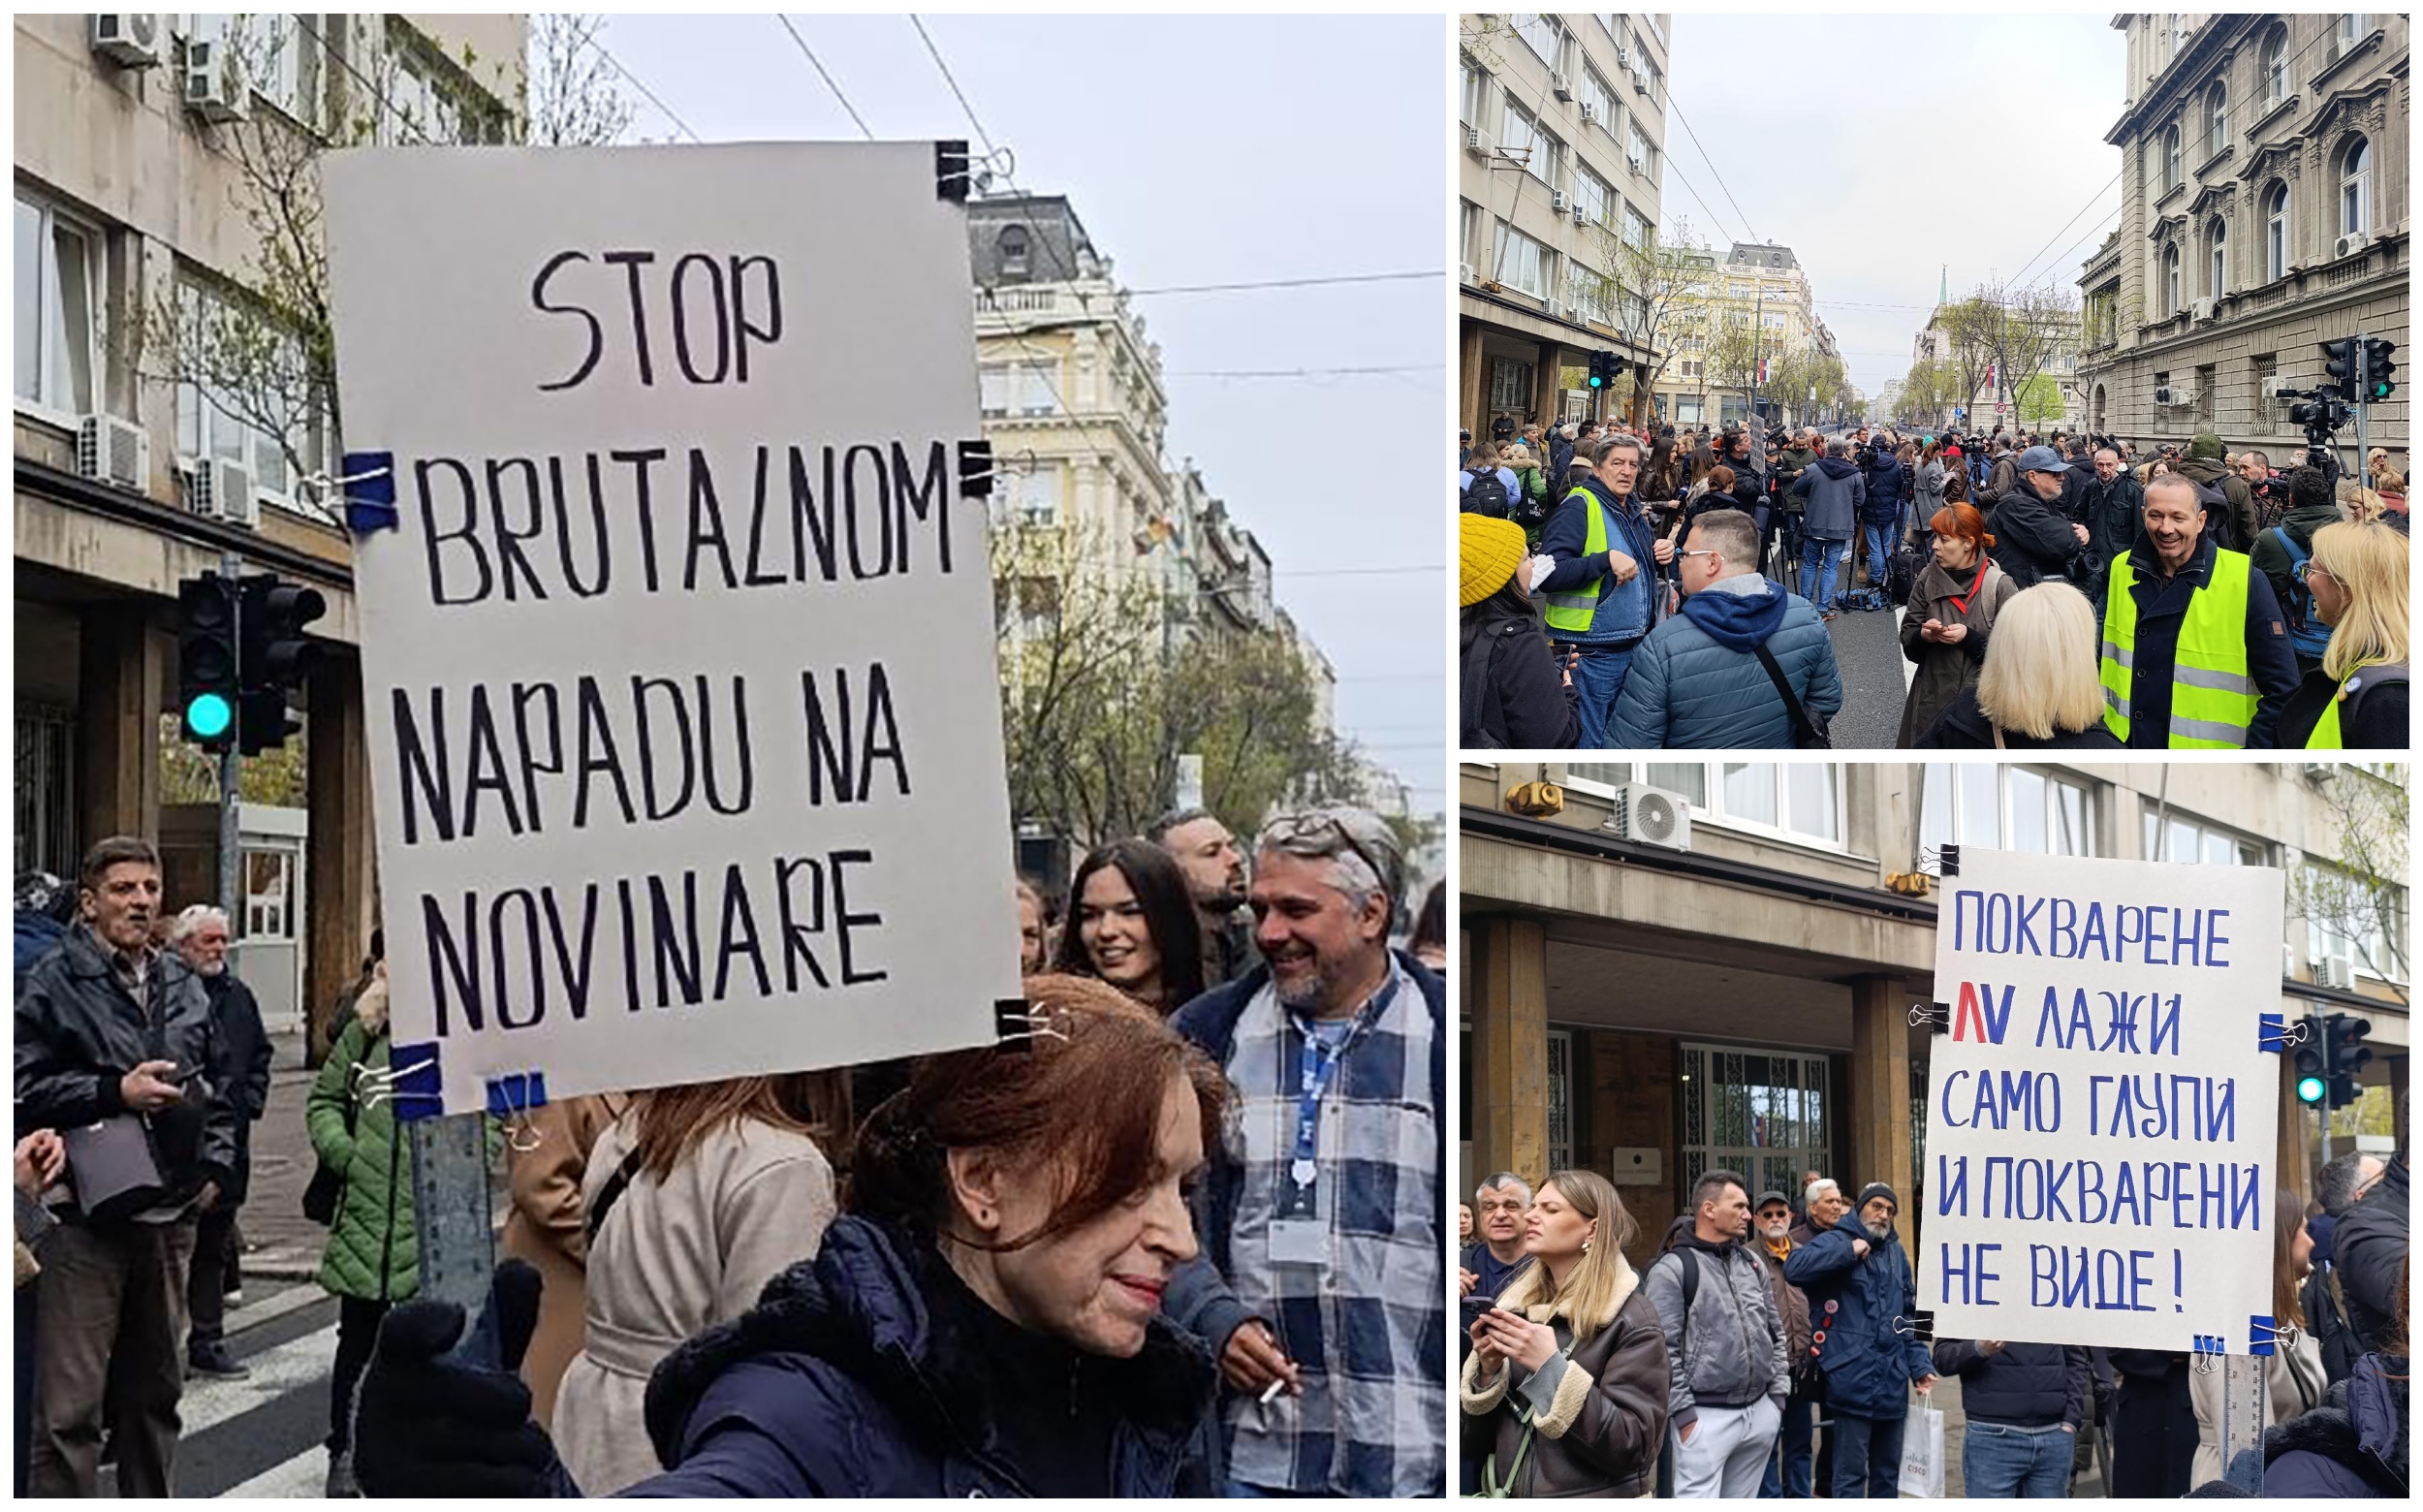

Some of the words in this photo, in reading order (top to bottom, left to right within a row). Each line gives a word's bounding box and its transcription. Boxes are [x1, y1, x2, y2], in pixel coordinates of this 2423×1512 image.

[532, 250, 782, 392] STOP
[414, 440, 952, 606] BRUTALNOM
[392, 675, 753, 845] NAPADU
[802, 662, 911, 806] NA
[422, 849, 887, 1037] NOVINARE
[1954, 890, 2230, 967] ПОКВАРЕНЕ
[2035, 986, 2182, 1056] ЛАЖИ
[1941, 1069, 2061, 1133] САМО
[2090, 1072, 2235, 1143] ГЛУПИ
[1938, 1154, 1967, 1217] И
[1982, 1156, 2260, 1232] ПОКВАРЕНИ
[1940, 1242, 2002, 1307] НЕ
